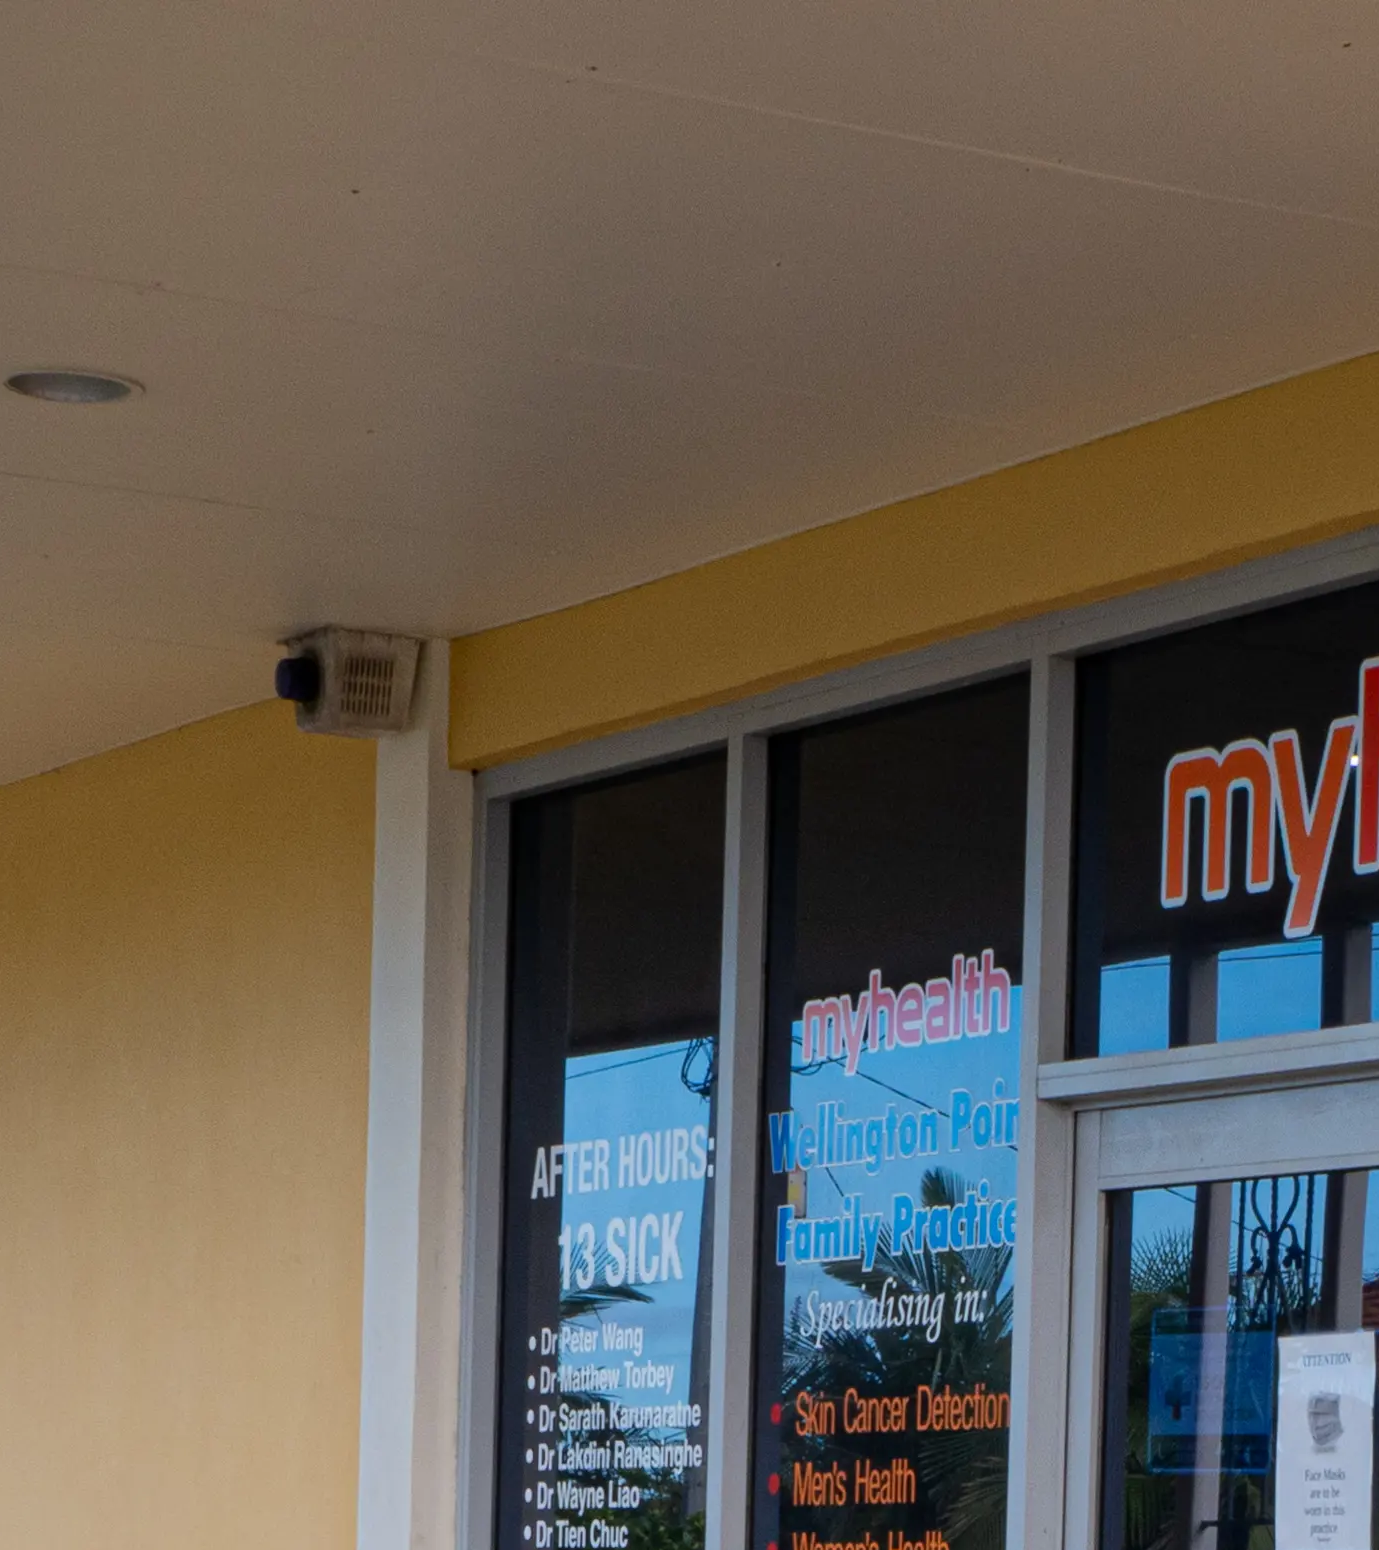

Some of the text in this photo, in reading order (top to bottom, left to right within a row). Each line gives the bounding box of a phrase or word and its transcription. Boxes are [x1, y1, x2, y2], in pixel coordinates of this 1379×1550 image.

[801, 948, 1012, 1077] myhealth
[768, 1077, 1020, 1177] Wellington Poin
[531, 1124, 715, 1199] AFTER HOURS:
[558, 1211, 684, 1290] 13 SICK
[776, 1178, 1018, 1274] Family Practice
[800, 1276, 988, 1349] Specialising in:
[541, 1323, 643, 1357] Dr Peter Wang
[540, 1360, 674, 1394] Dr Matthew Torbey
[538, 1400, 701, 1433] Dr Sarath Karunaratne
[795, 1383, 1011, 1437] Skin Cancer Detection
[537, 1438, 703, 1474] Dr Lakdini Ranasinghe
[536, 1480, 640, 1516] Dr Wayne Liao
[792, 1458, 916, 1506] Men's Health
[535, 1519, 629, 1549] Dr Tien Chuc
